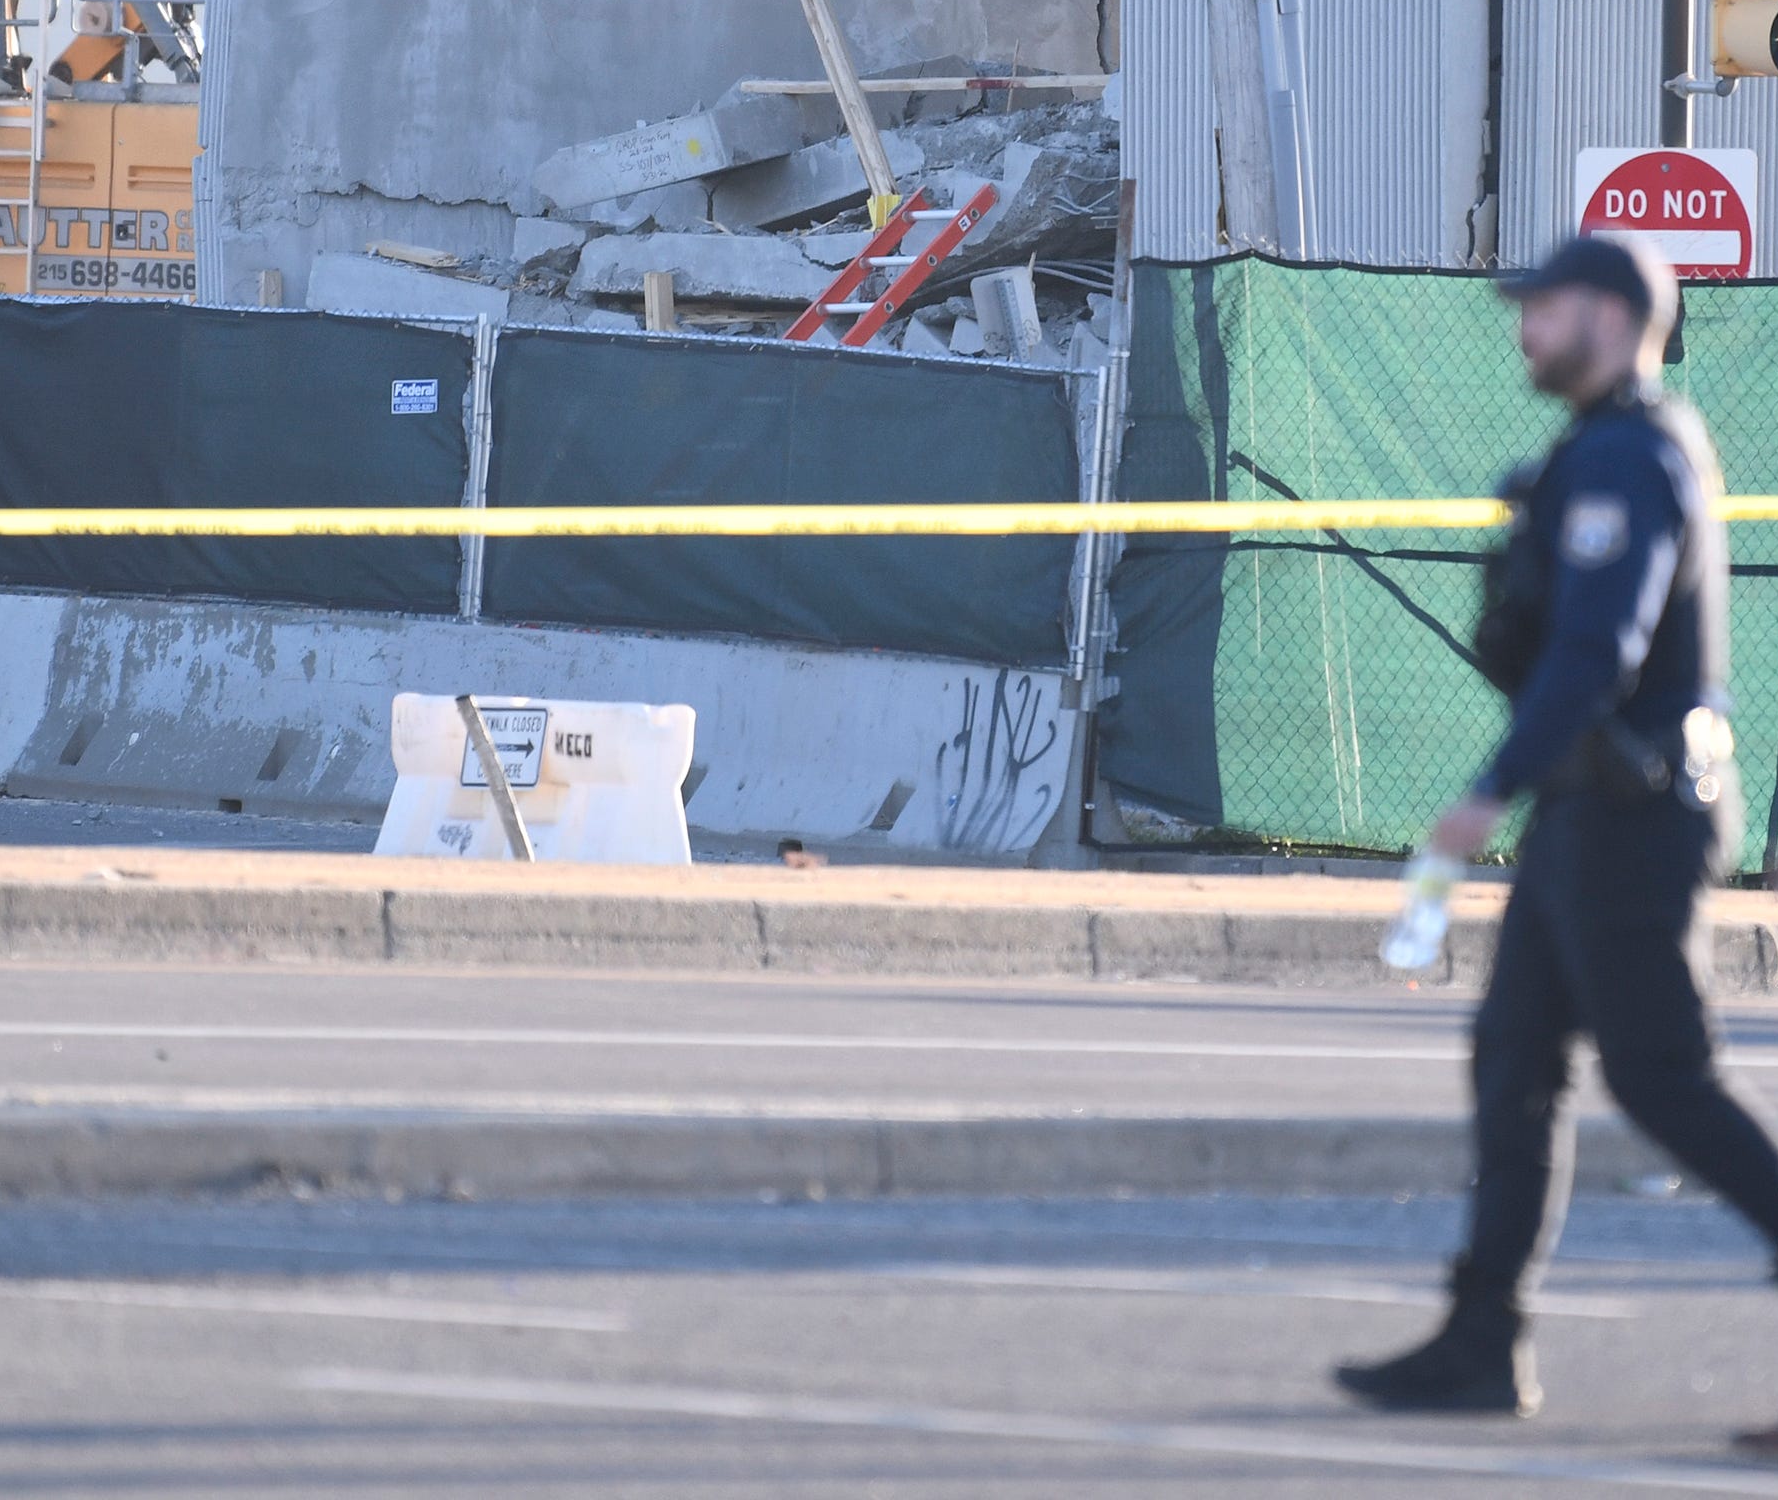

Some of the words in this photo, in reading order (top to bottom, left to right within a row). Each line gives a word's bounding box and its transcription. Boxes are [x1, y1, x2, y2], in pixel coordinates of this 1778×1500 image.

[1605, 188, 1648, 219] DO
[1662, 189, 1728, 219] NOT
[37, 263, 68, 281] 215
[70, 260, 196, 291] 698-4466
[395, 383, 435, 396] Federal
[511, 717, 543, 733] CLOSED
